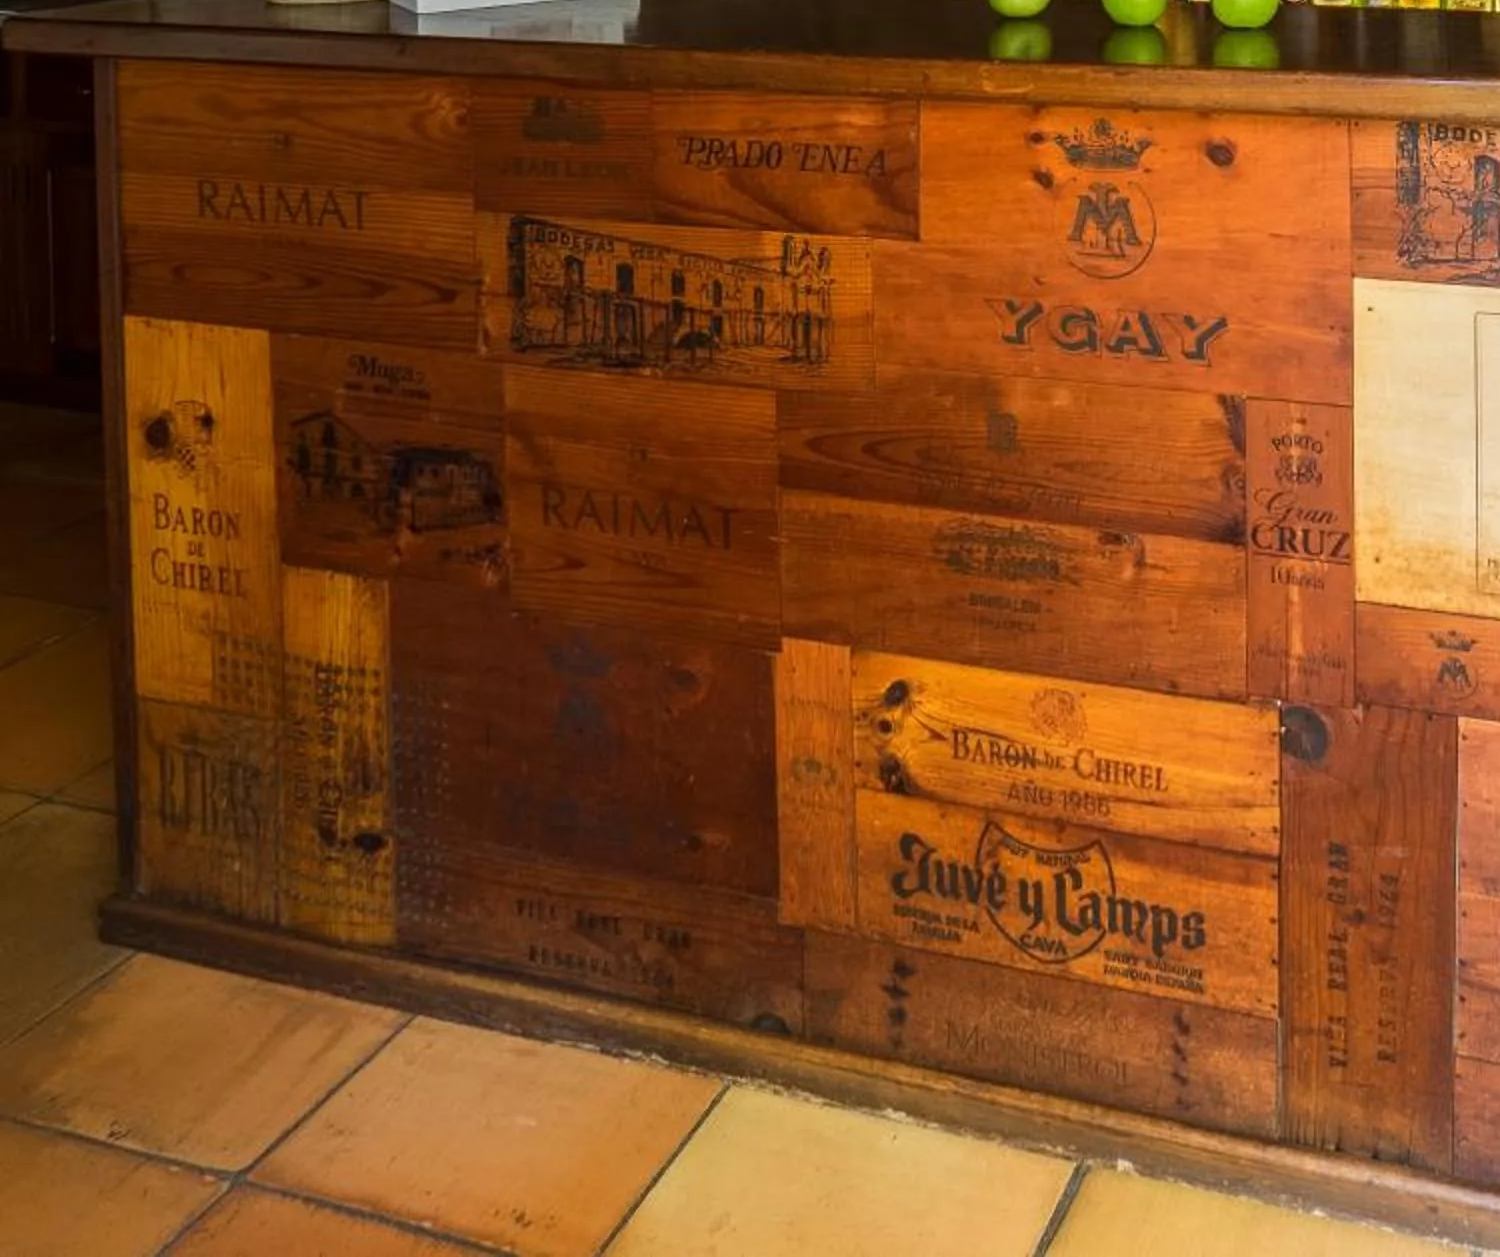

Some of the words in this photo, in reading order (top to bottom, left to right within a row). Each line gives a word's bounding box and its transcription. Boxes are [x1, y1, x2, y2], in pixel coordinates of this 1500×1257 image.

[676, 136, 783, 172] PRADO
[791, 141, 889, 178] ENEA
[196, 178, 370, 231] RAIMAT
[983, 296, 1231, 368] YGAY
[152, 492, 242, 543] BARON
[539, 479, 744, 551] RAIMAT
[1250, 524, 1352, 560] CRUZ
[150, 546, 250, 601] CHIREL
[950, 727, 1039, 771] BARON
[1073, 746, 1170, 793] CHIREL
[891, 832, 1007, 910] Juvé
[1019, 877, 1045, 932] y
[1053, 866, 1207, 958] Camps
